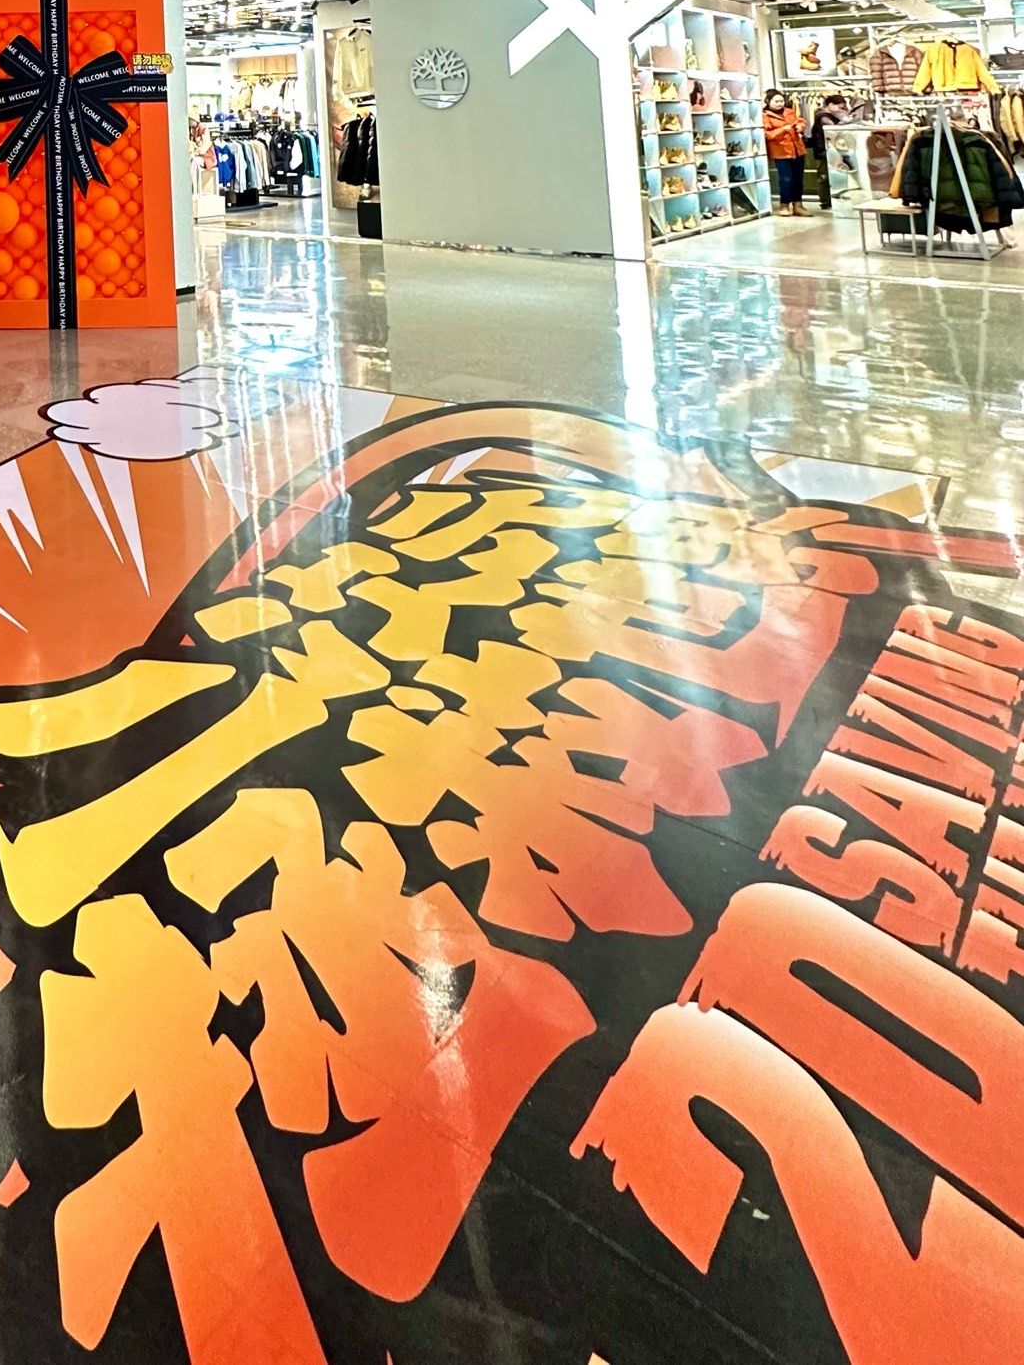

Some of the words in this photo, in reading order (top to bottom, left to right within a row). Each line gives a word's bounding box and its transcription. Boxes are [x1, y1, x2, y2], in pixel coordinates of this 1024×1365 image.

[50, 8, 58, 32] HAPPY
[51, 32, 59, 68] BIRTHDAY
[18, 53, 46, 78] WELCOME
[77, 71, 110, 85] WELCOME
[22, 110, 45, 139] WELCOME
[70, 123, 83, 153] WELCOME
[101, 120, 122, 139] WELCO
[54, 130, 62, 154] HAPPY
[55, 155, 63, 192] BIRTHDAY
[56, 192, 64, 217] HAPPY
[57, 218, 65, 254] BIRTHDAY
[758, 604, 1024, 959] SAVING
